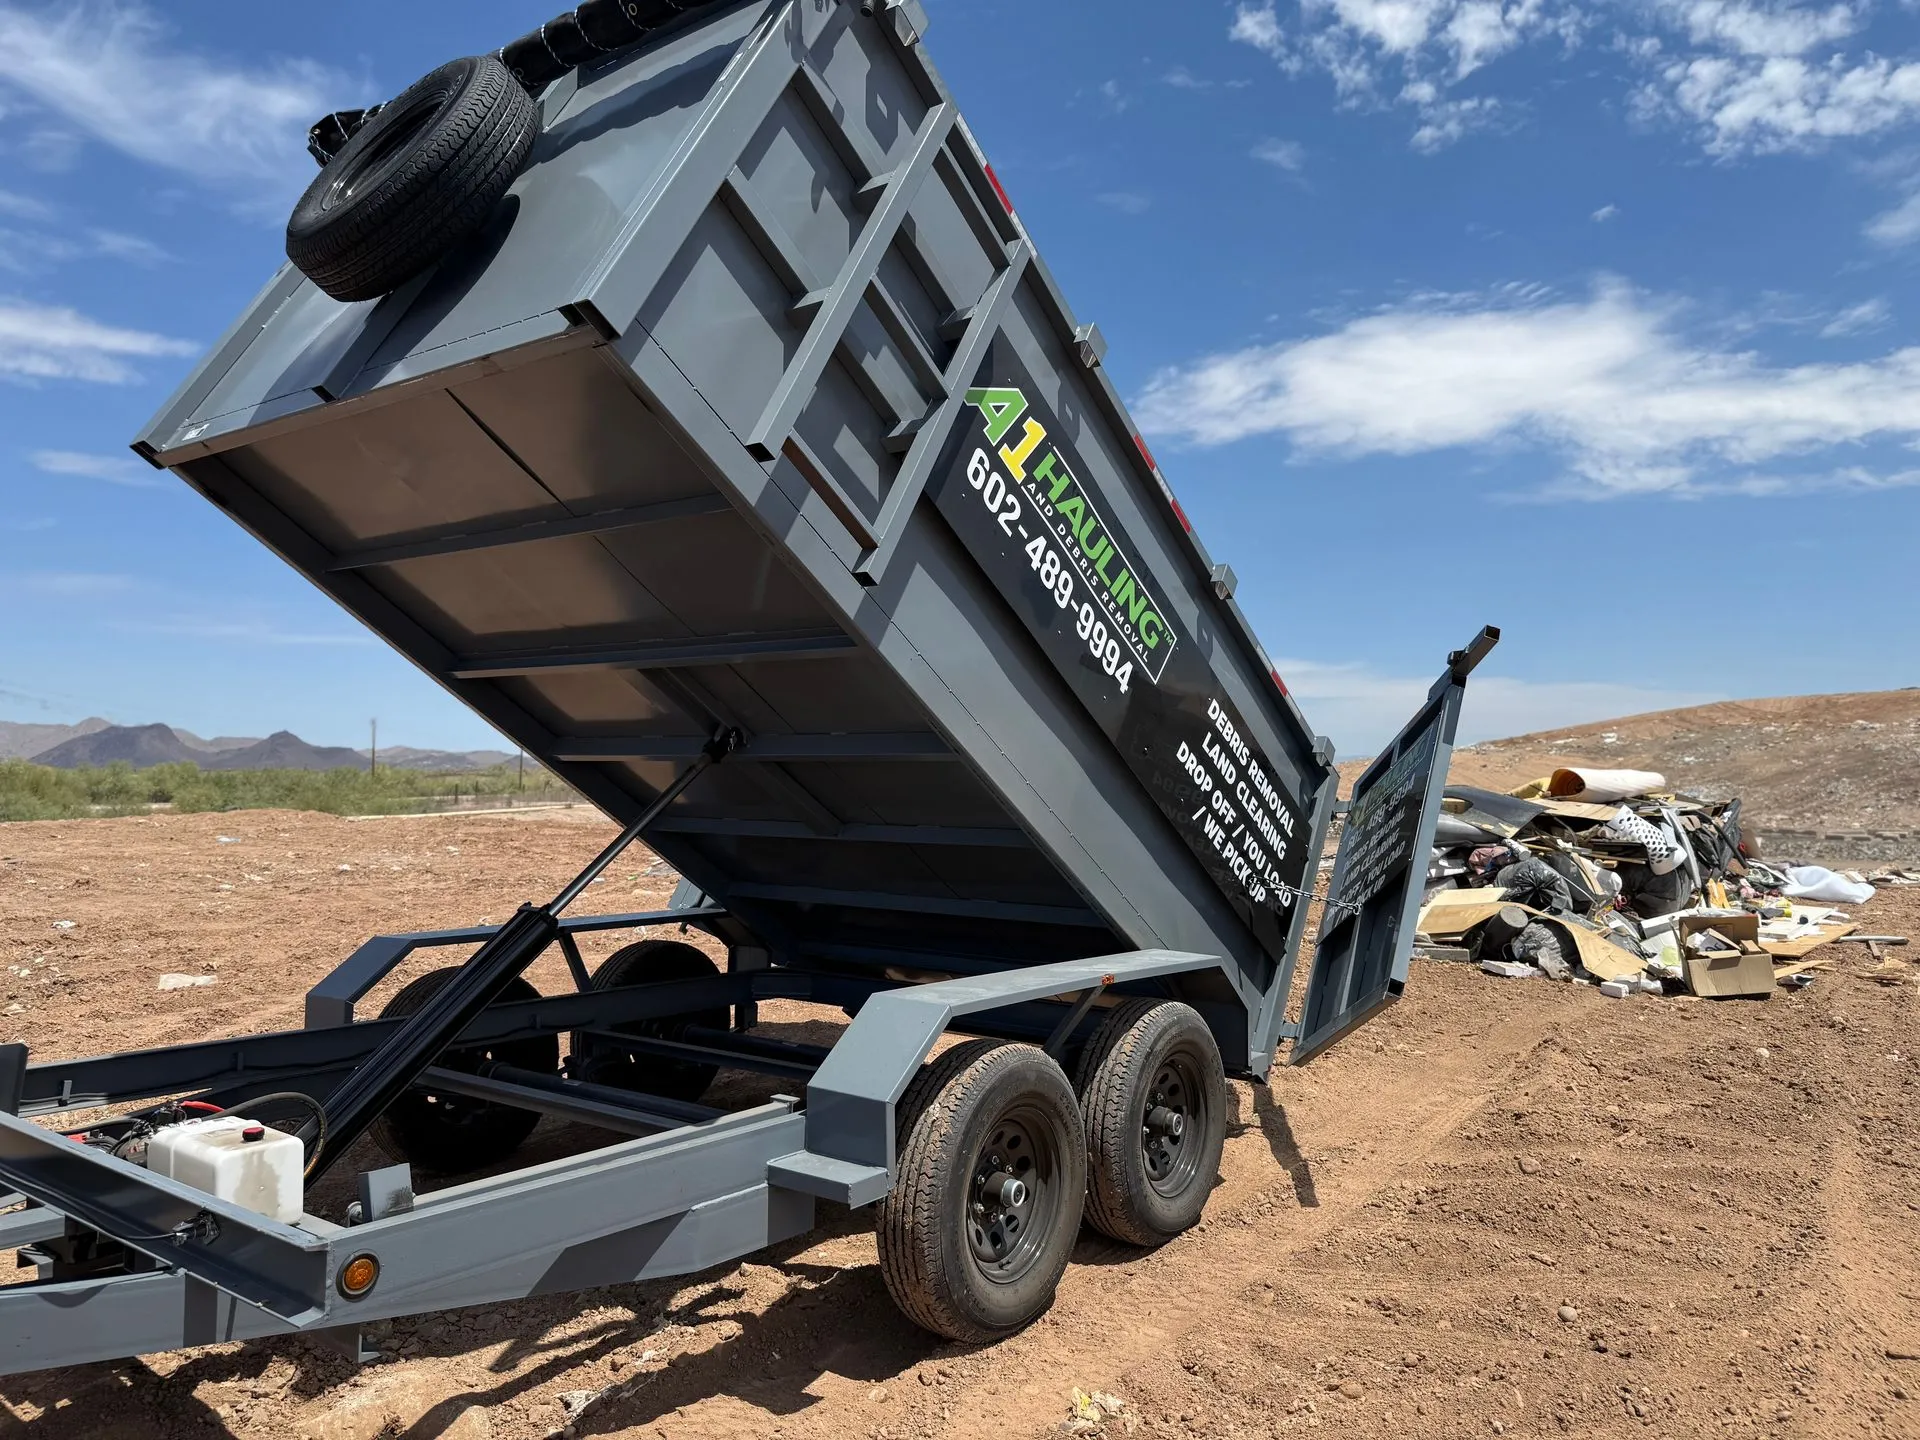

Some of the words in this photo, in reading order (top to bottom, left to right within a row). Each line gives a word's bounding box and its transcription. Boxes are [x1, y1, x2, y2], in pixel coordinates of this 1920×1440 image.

[964, 387, 1047, 485] A1
[966, 447, 1133, 694] 602-489-9994
[1027, 483, 1053, 517] AND
[1057, 524, 1098, 586] DEBRIS
[1101, 591, 1148, 662] REMOVAL
[1033, 452, 1164, 649] HAULING
[1176, 741, 1213, 792] DROP
[1212, 789, 1236, 825] OFF
[1242, 831, 1266, 869] YOU
[1264, 864, 1292, 908] LOAD
[1202, 732, 1236, 785] LAND
[1236, 781, 1287, 860] CLEARING
[1207, 698, 1249, 766] DEBRIS
[1248, 759, 1294, 838] REMOVAL
[1203, 814, 1226, 850] WE
[1222, 849, 1252, 887] PICK
